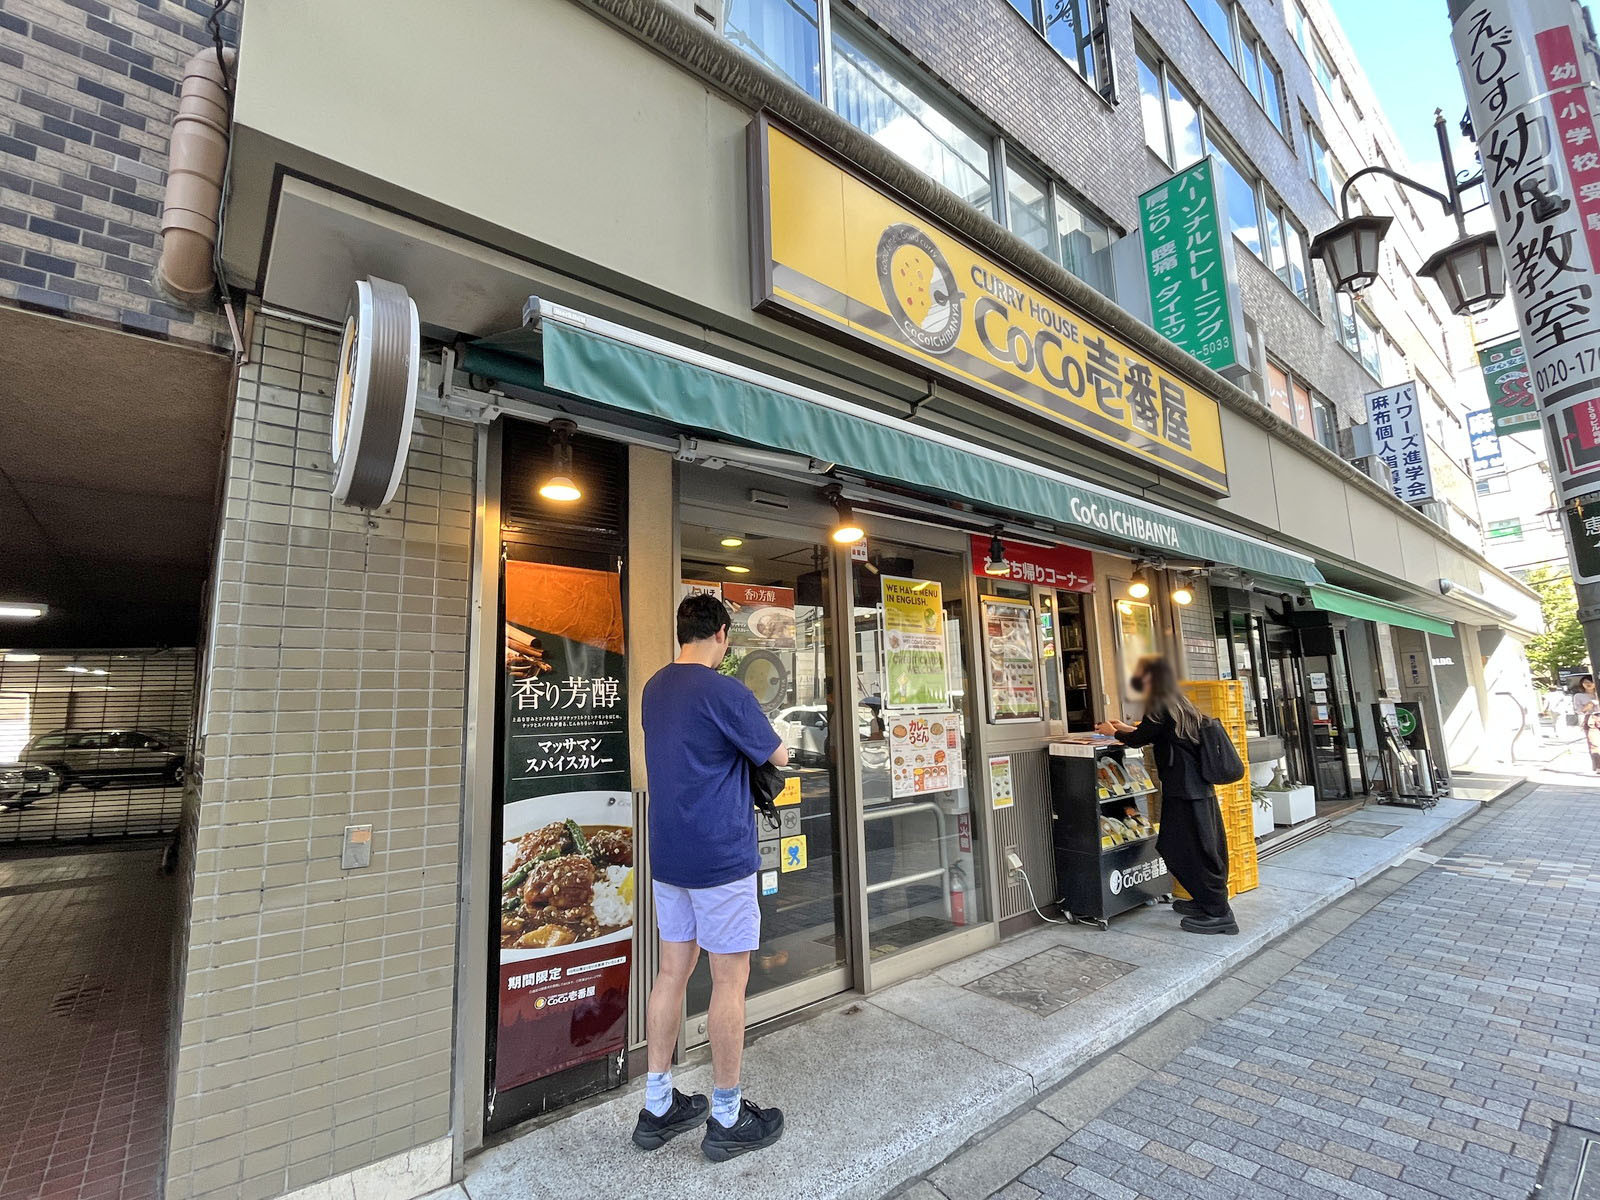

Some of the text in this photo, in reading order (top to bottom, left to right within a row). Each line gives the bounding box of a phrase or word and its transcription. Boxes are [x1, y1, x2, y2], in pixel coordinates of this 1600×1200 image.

[971, 264, 1079, 343] CURRY HOUSE
[1536, 348, 1600, 393] 0120-17
[1395, 388, 1427, 497] パワーズ進学会
[1070, 497, 1180, 549] CoCo ICHIBANYA
[744, 588, 776, 602] 香り芳醇
[886, 584, 898, 593] WE
[886, 594, 895, 602] IN
[511, 676, 621, 710] 香り芳醇
[909, 720, 929, 732] カレー
[538, 737, 602, 754] マッサマン
[525, 755, 613, 773] スパイスカレー
[508, 967, 561, 990] 期間限定
